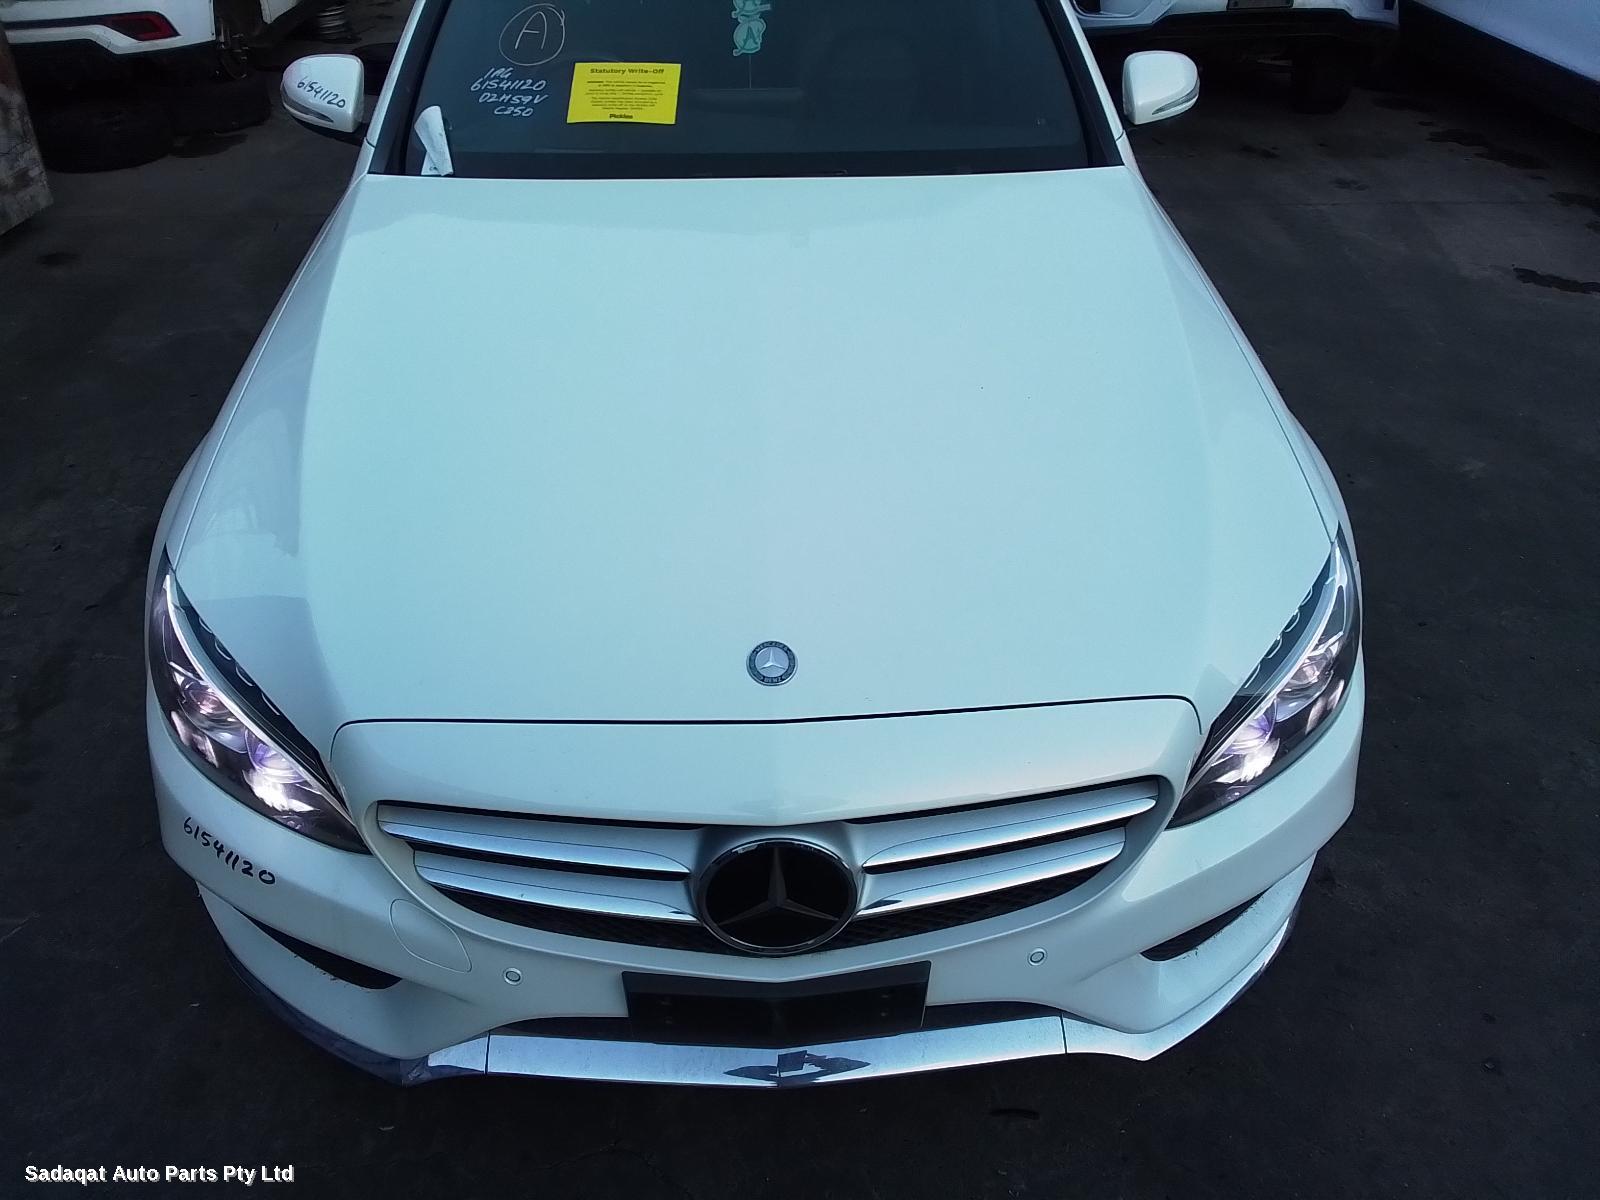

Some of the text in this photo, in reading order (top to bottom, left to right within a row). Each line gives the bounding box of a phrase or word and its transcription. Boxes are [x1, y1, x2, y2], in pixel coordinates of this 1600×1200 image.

[515, 11, 548, 50] A
[297, 76, 346, 108] 61541120
[471, 78, 546, 91] 61541120
[494, 106, 534, 117] C250
[183, 816, 276, 885] 61541120
